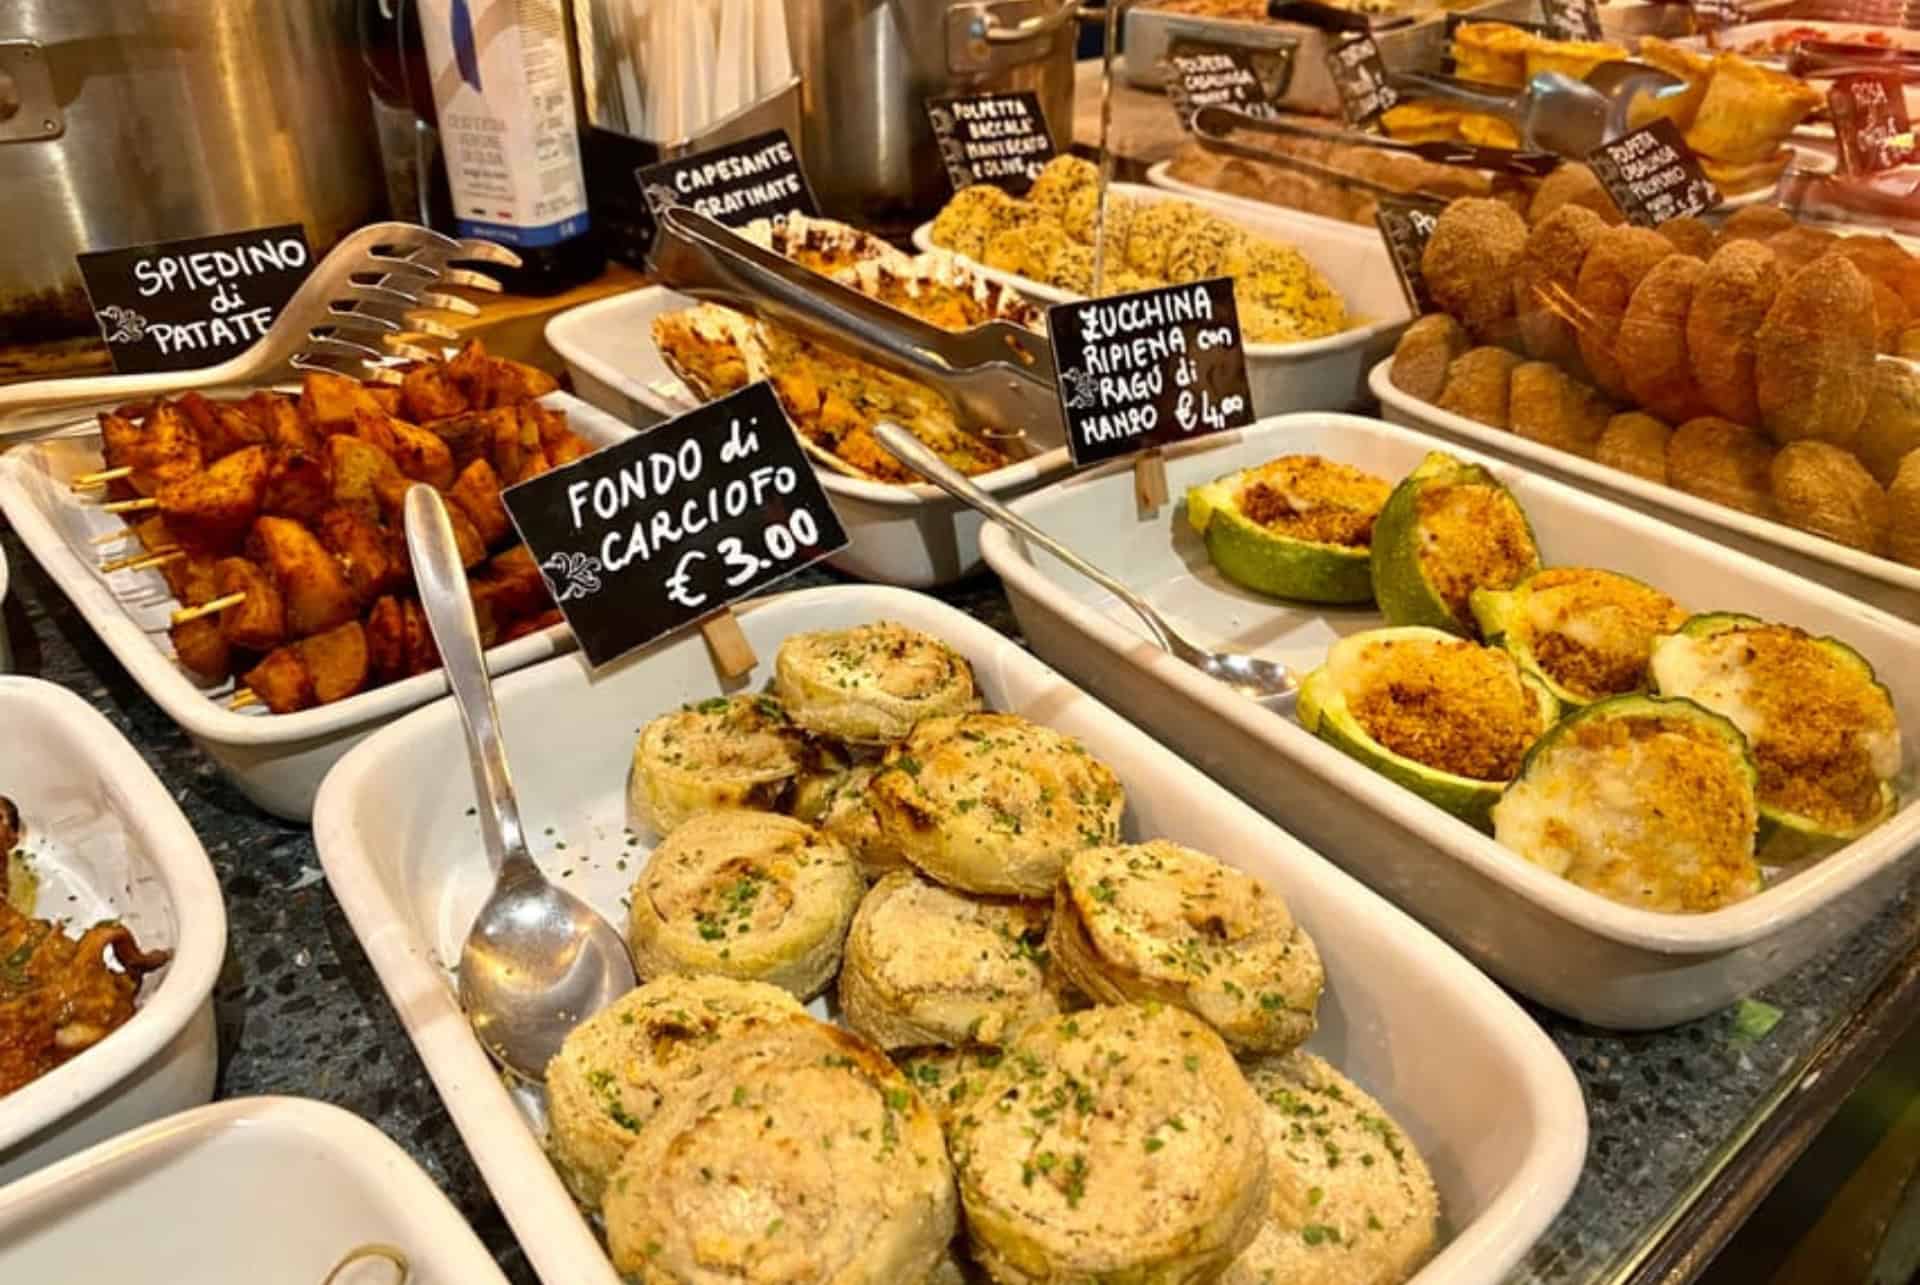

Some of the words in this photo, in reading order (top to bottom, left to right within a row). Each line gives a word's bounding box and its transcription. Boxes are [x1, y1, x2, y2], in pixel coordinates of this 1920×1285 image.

[952, 98, 1028, 121] POLPETTA
[674, 141, 793, 194] CAPESANTE
[693, 173, 801, 217] GRATINATE
[134, 238, 308, 297] SPIEDINO
[210, 283, 246, 313] di
[1077, 285, 1213, 343] ZUCCHINA
[145, 306, 273, 356] PATATE
[1081, 325, 1187, 375] RIPIENA
[1175, 356, 1199, 387] di
[567, 438, 703, 529] FONDO
[719, 417, 760, 464] di
[600, 466, 797, 571] CARCIOFO
[664, 551, 707, 607] €
[716, 507, 819, 587] 3.00
